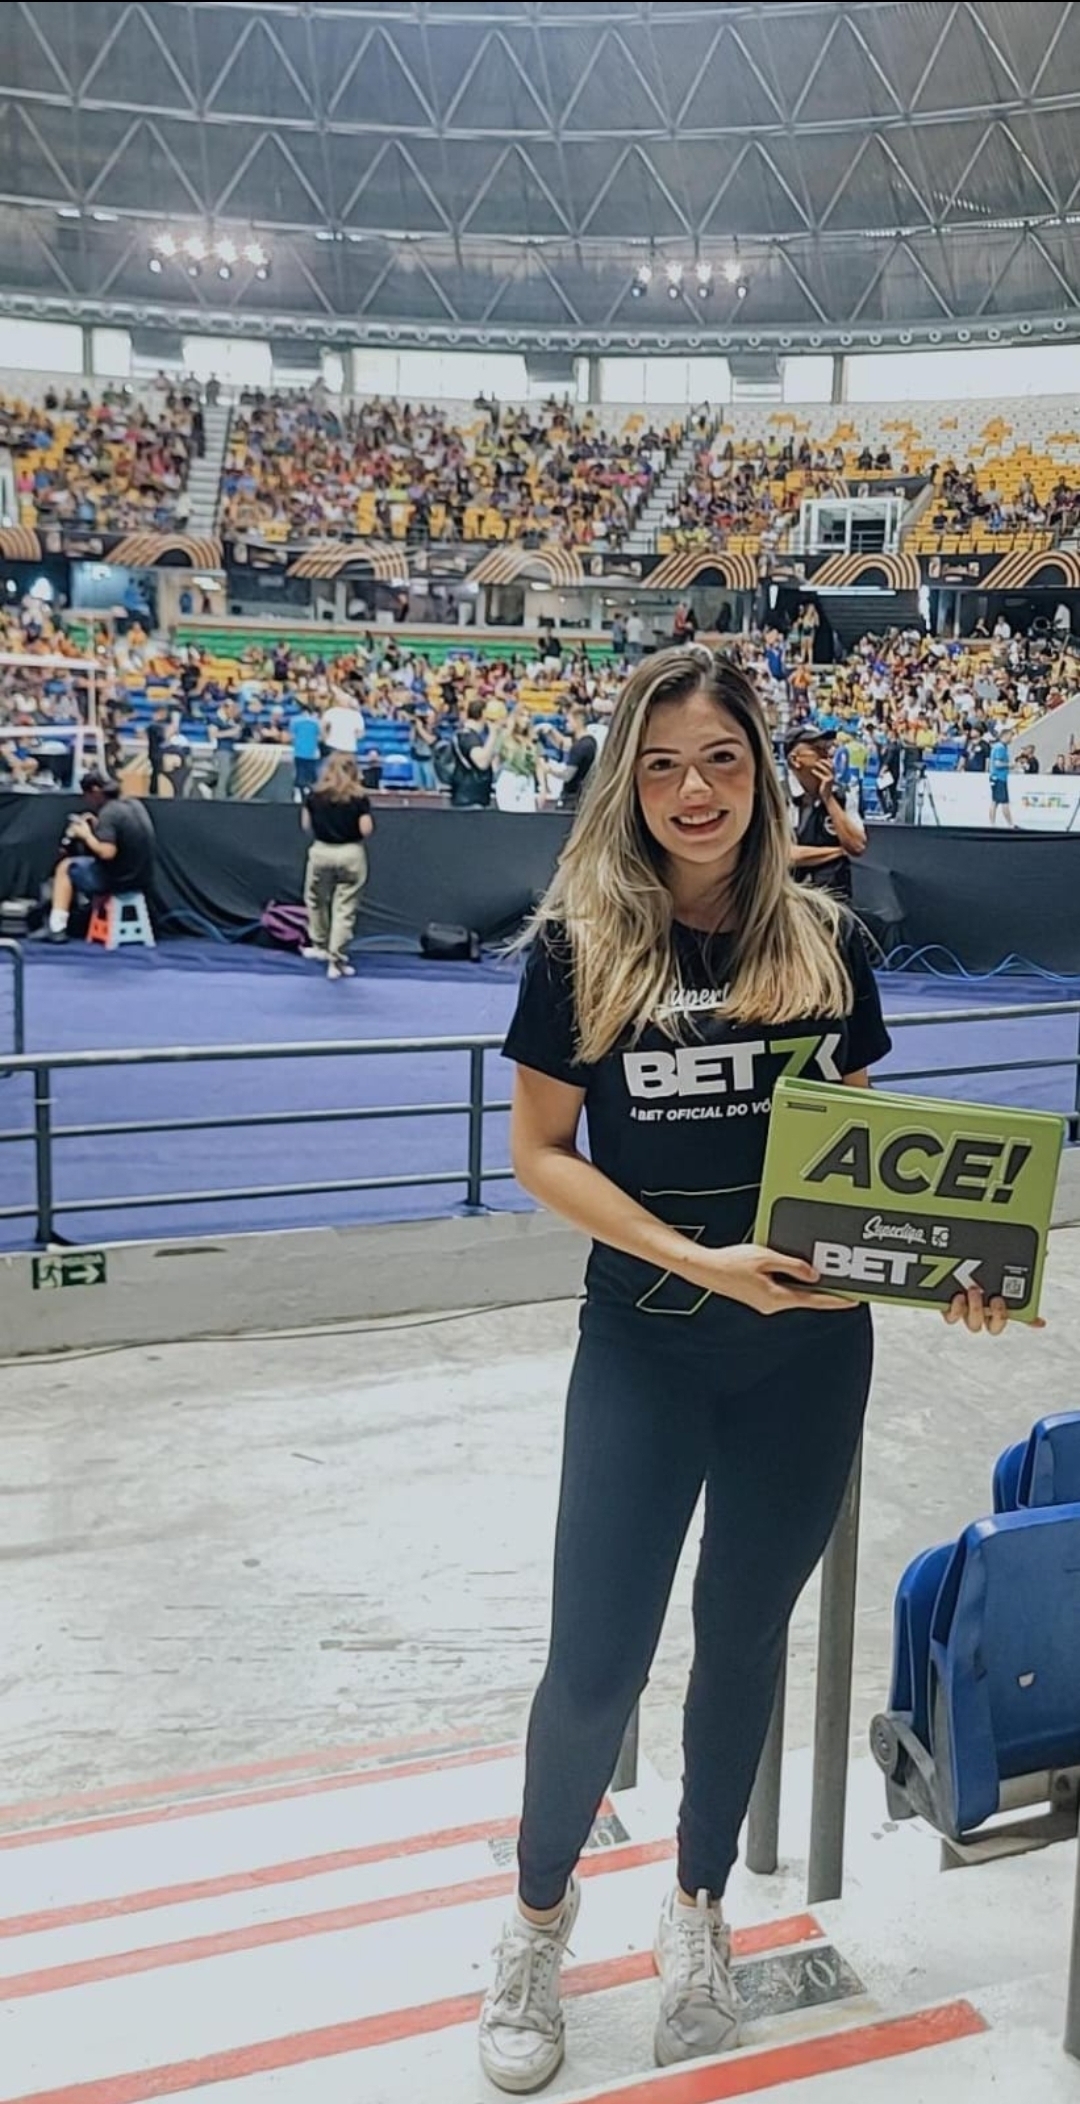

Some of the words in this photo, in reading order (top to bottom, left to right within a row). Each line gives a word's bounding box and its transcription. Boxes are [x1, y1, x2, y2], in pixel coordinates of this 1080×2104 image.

[637, 1109, 664, 1121] BET
[666, 1106, 723, 1121] OFICIAL
[726, 1103, 748, 1117] DO
[802, 1124, 1032, 1204] ACE!
